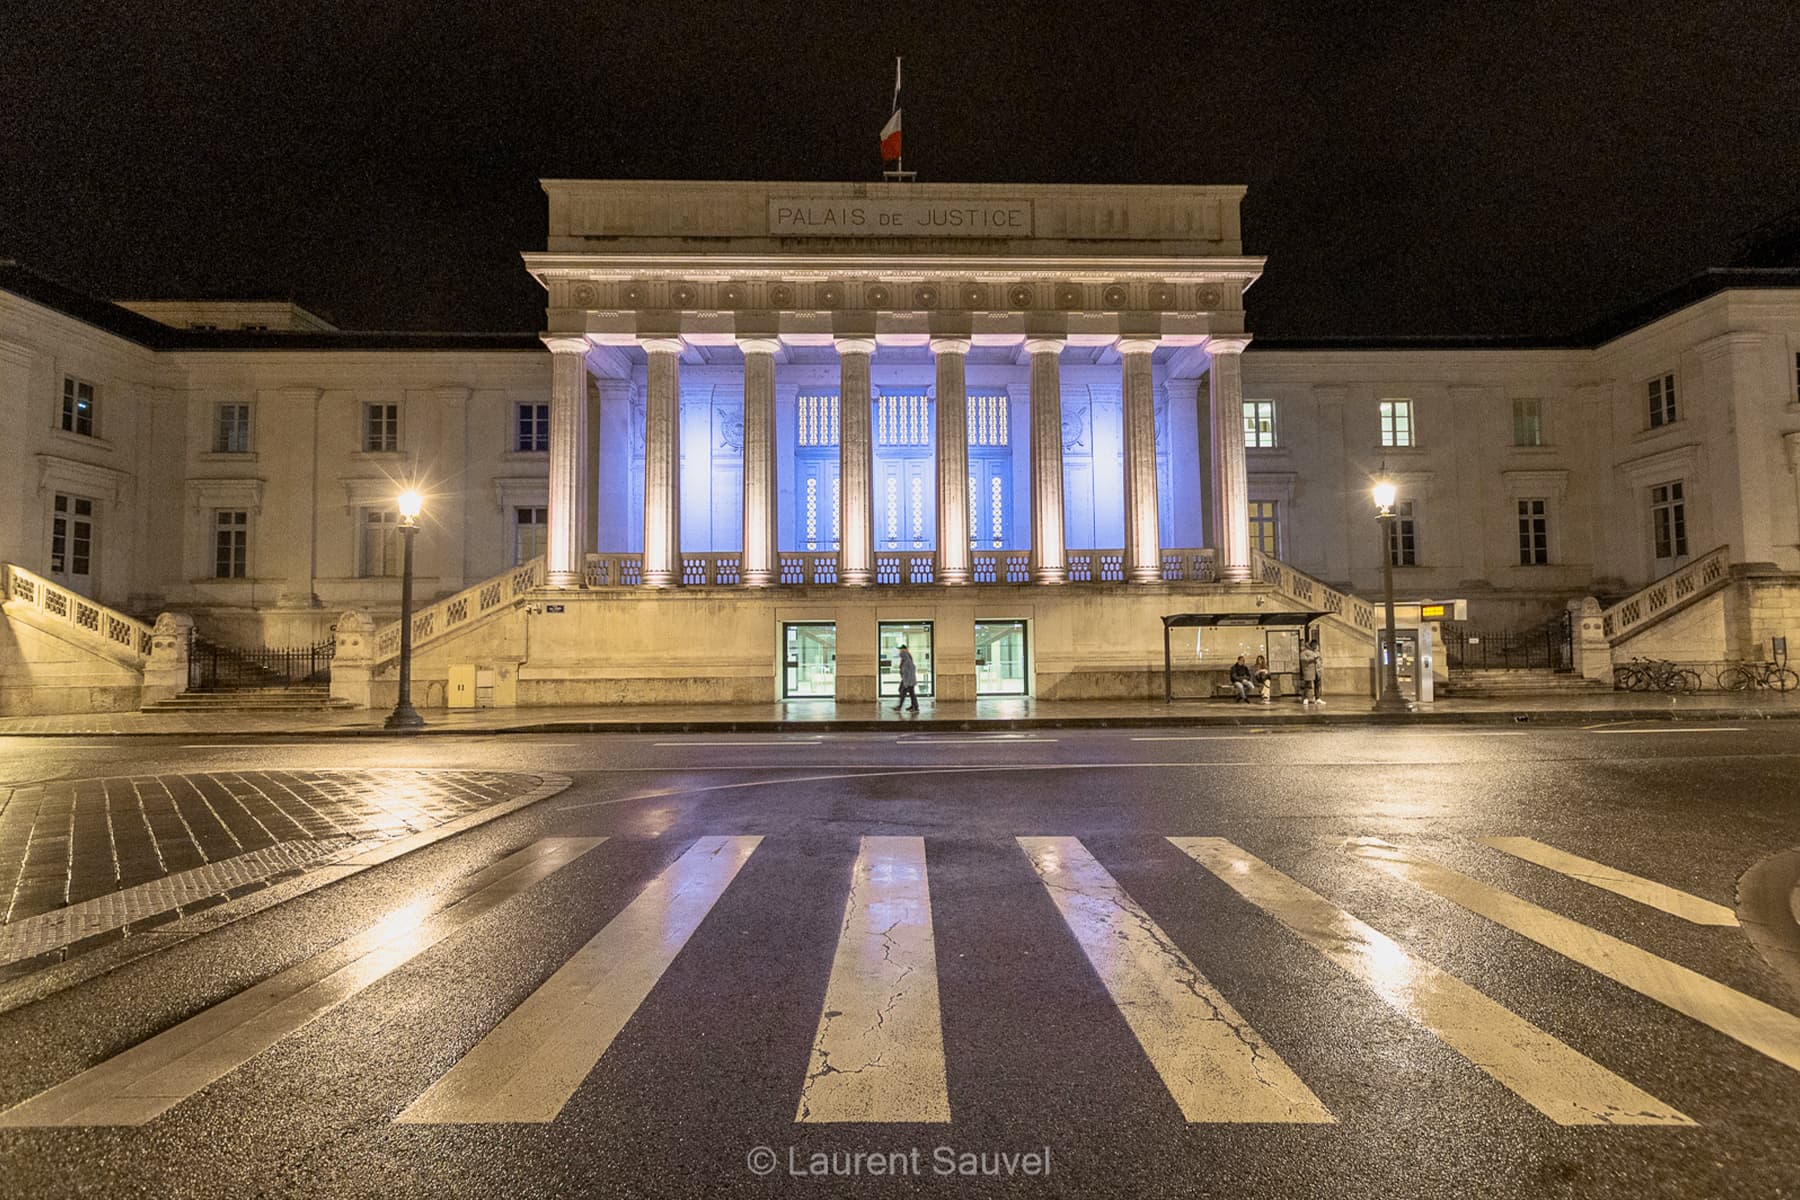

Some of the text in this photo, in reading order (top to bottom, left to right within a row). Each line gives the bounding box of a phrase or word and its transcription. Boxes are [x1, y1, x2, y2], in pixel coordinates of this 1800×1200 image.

[778, 208, 1022, 227] PALAIS DE JUSTICE
